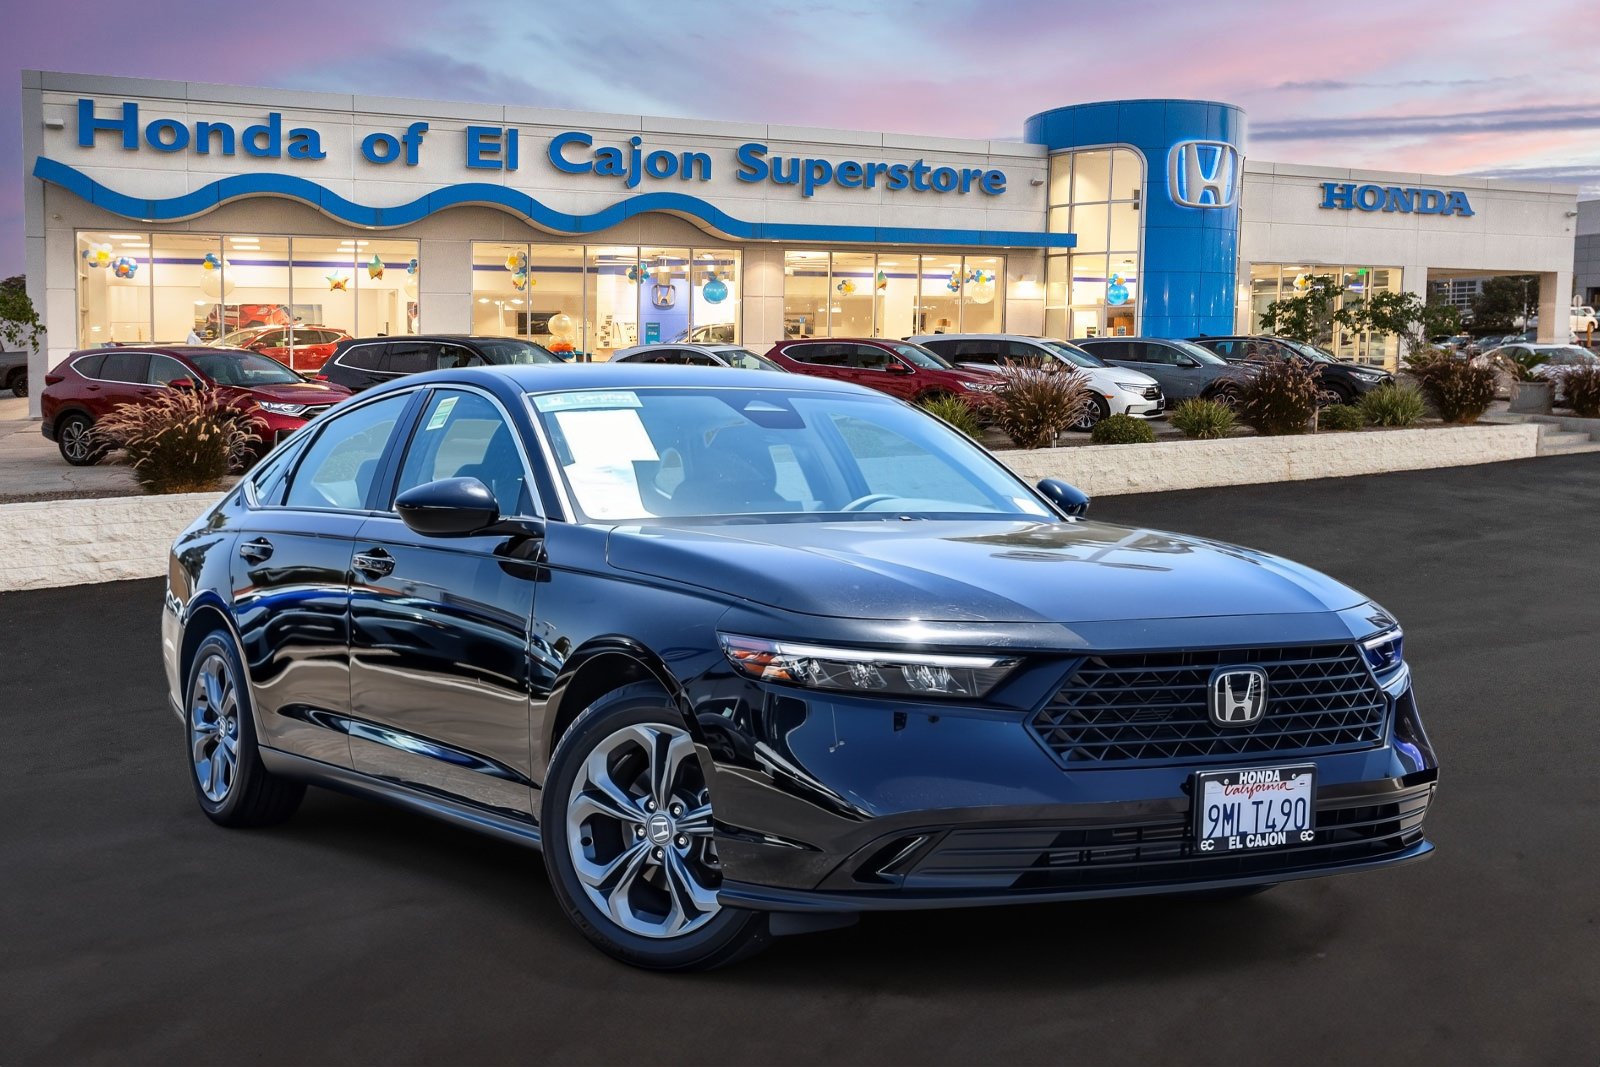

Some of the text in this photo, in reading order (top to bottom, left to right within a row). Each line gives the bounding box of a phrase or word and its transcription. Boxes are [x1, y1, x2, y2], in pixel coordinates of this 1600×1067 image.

[78, 98, 1008, 198] Honda of El Cajon Superstore
[1318, 181, 1476, 217] HONDA
[1224, 781, 1294, 800] California
[1238, 769, 1281, 785] HONDA
[1207, 797, 1307, 839] 9MLT490
[1228, 831, 1287, 850] EL CAJON
